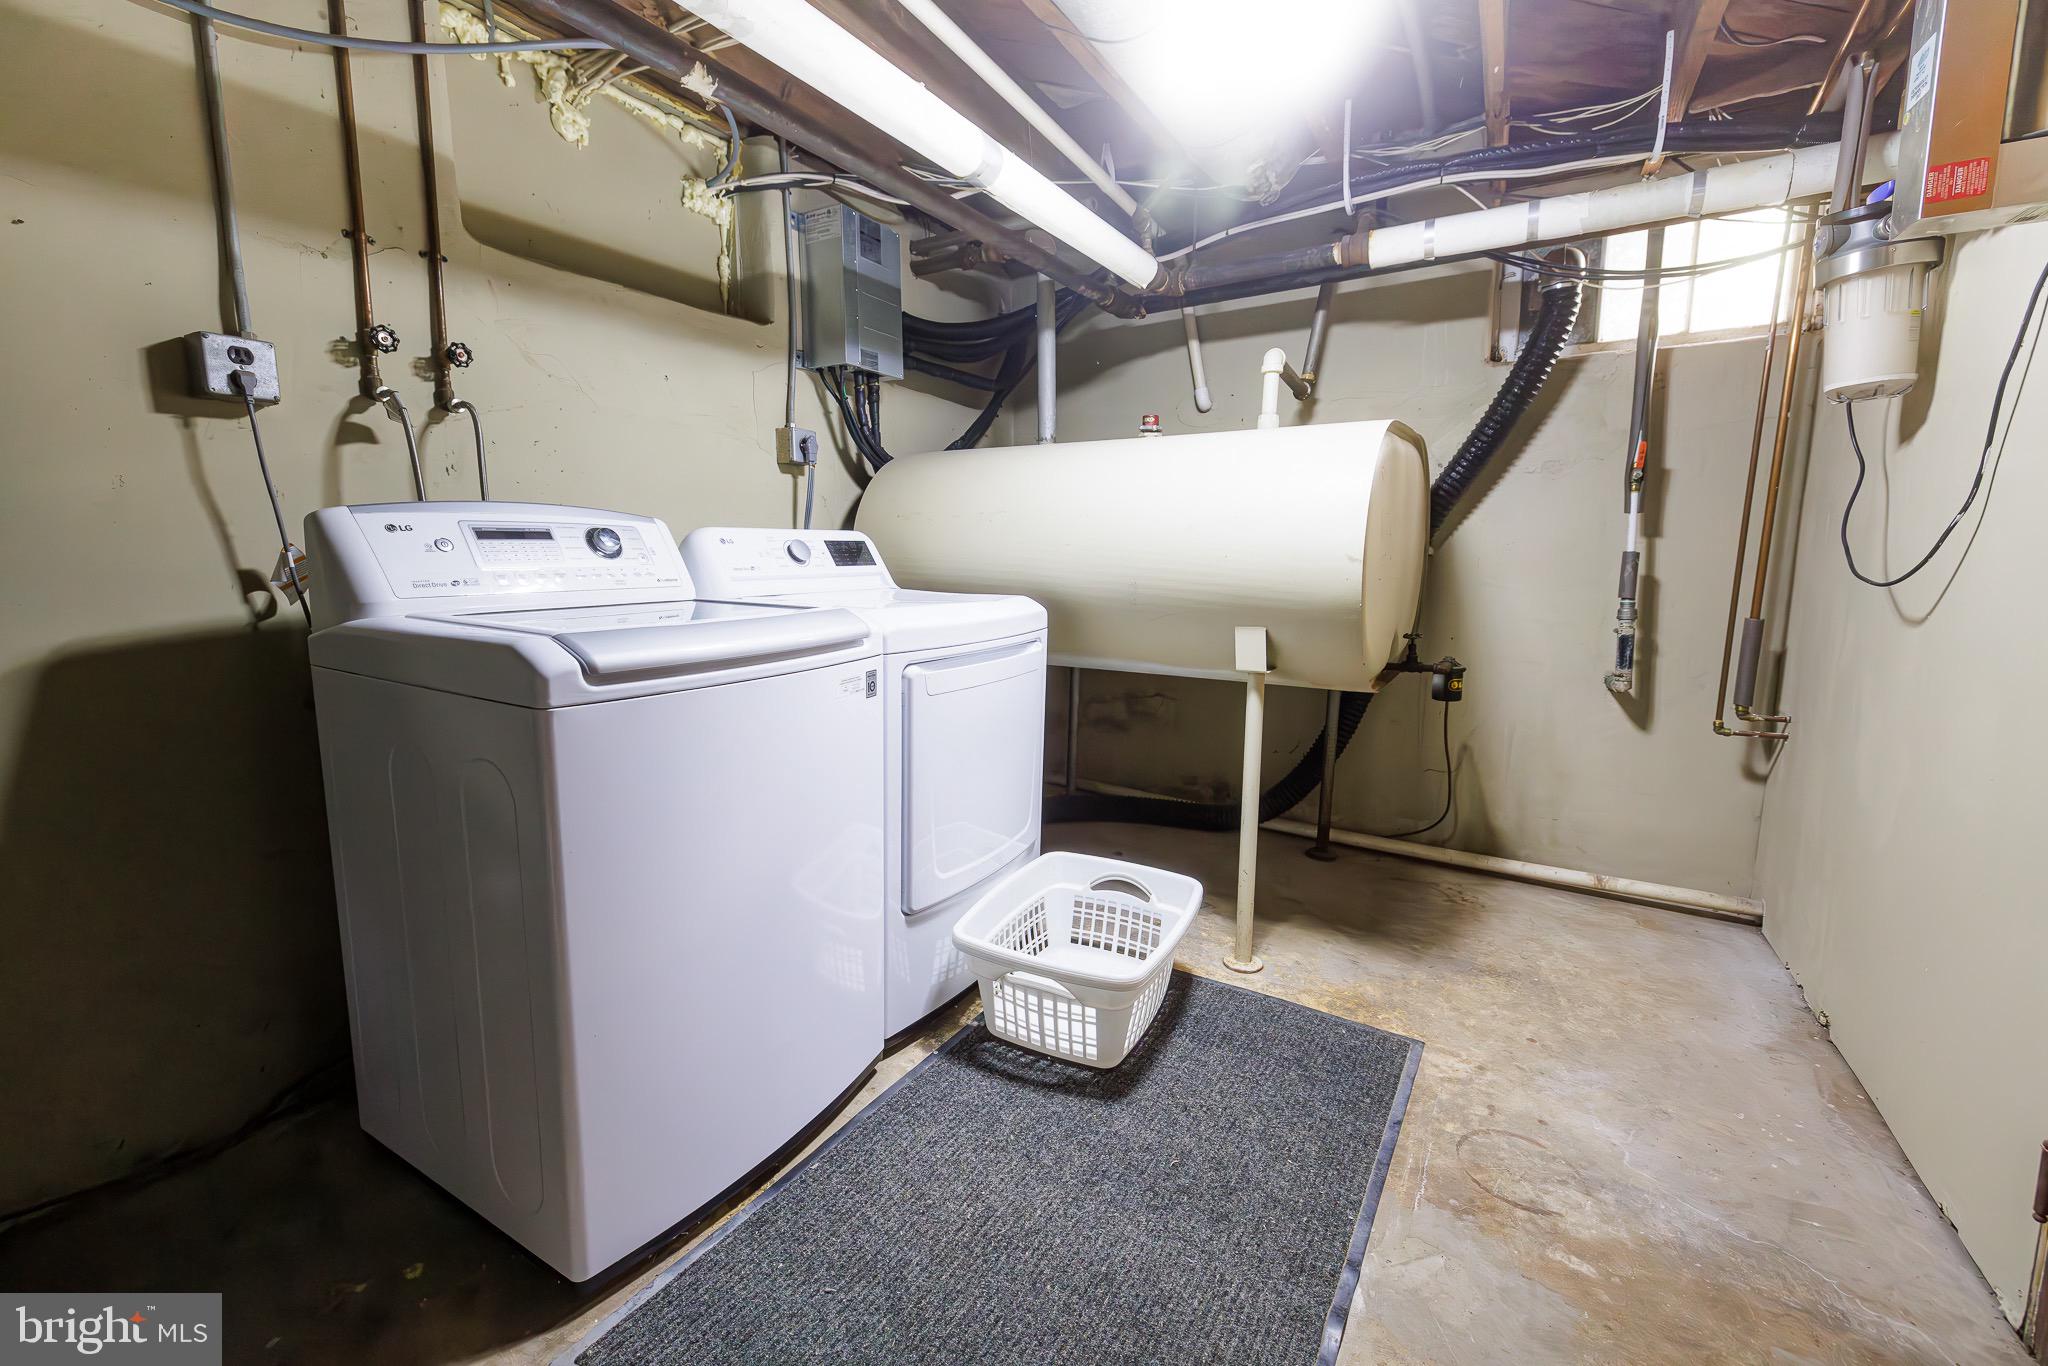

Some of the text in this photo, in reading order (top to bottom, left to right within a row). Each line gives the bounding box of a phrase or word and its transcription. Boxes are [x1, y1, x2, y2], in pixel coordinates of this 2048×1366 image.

[1926, 171, 1934, 198] DANGER
[1955, 167, 1963, 193] DANGER
[398, 524, 413, 532] LG
